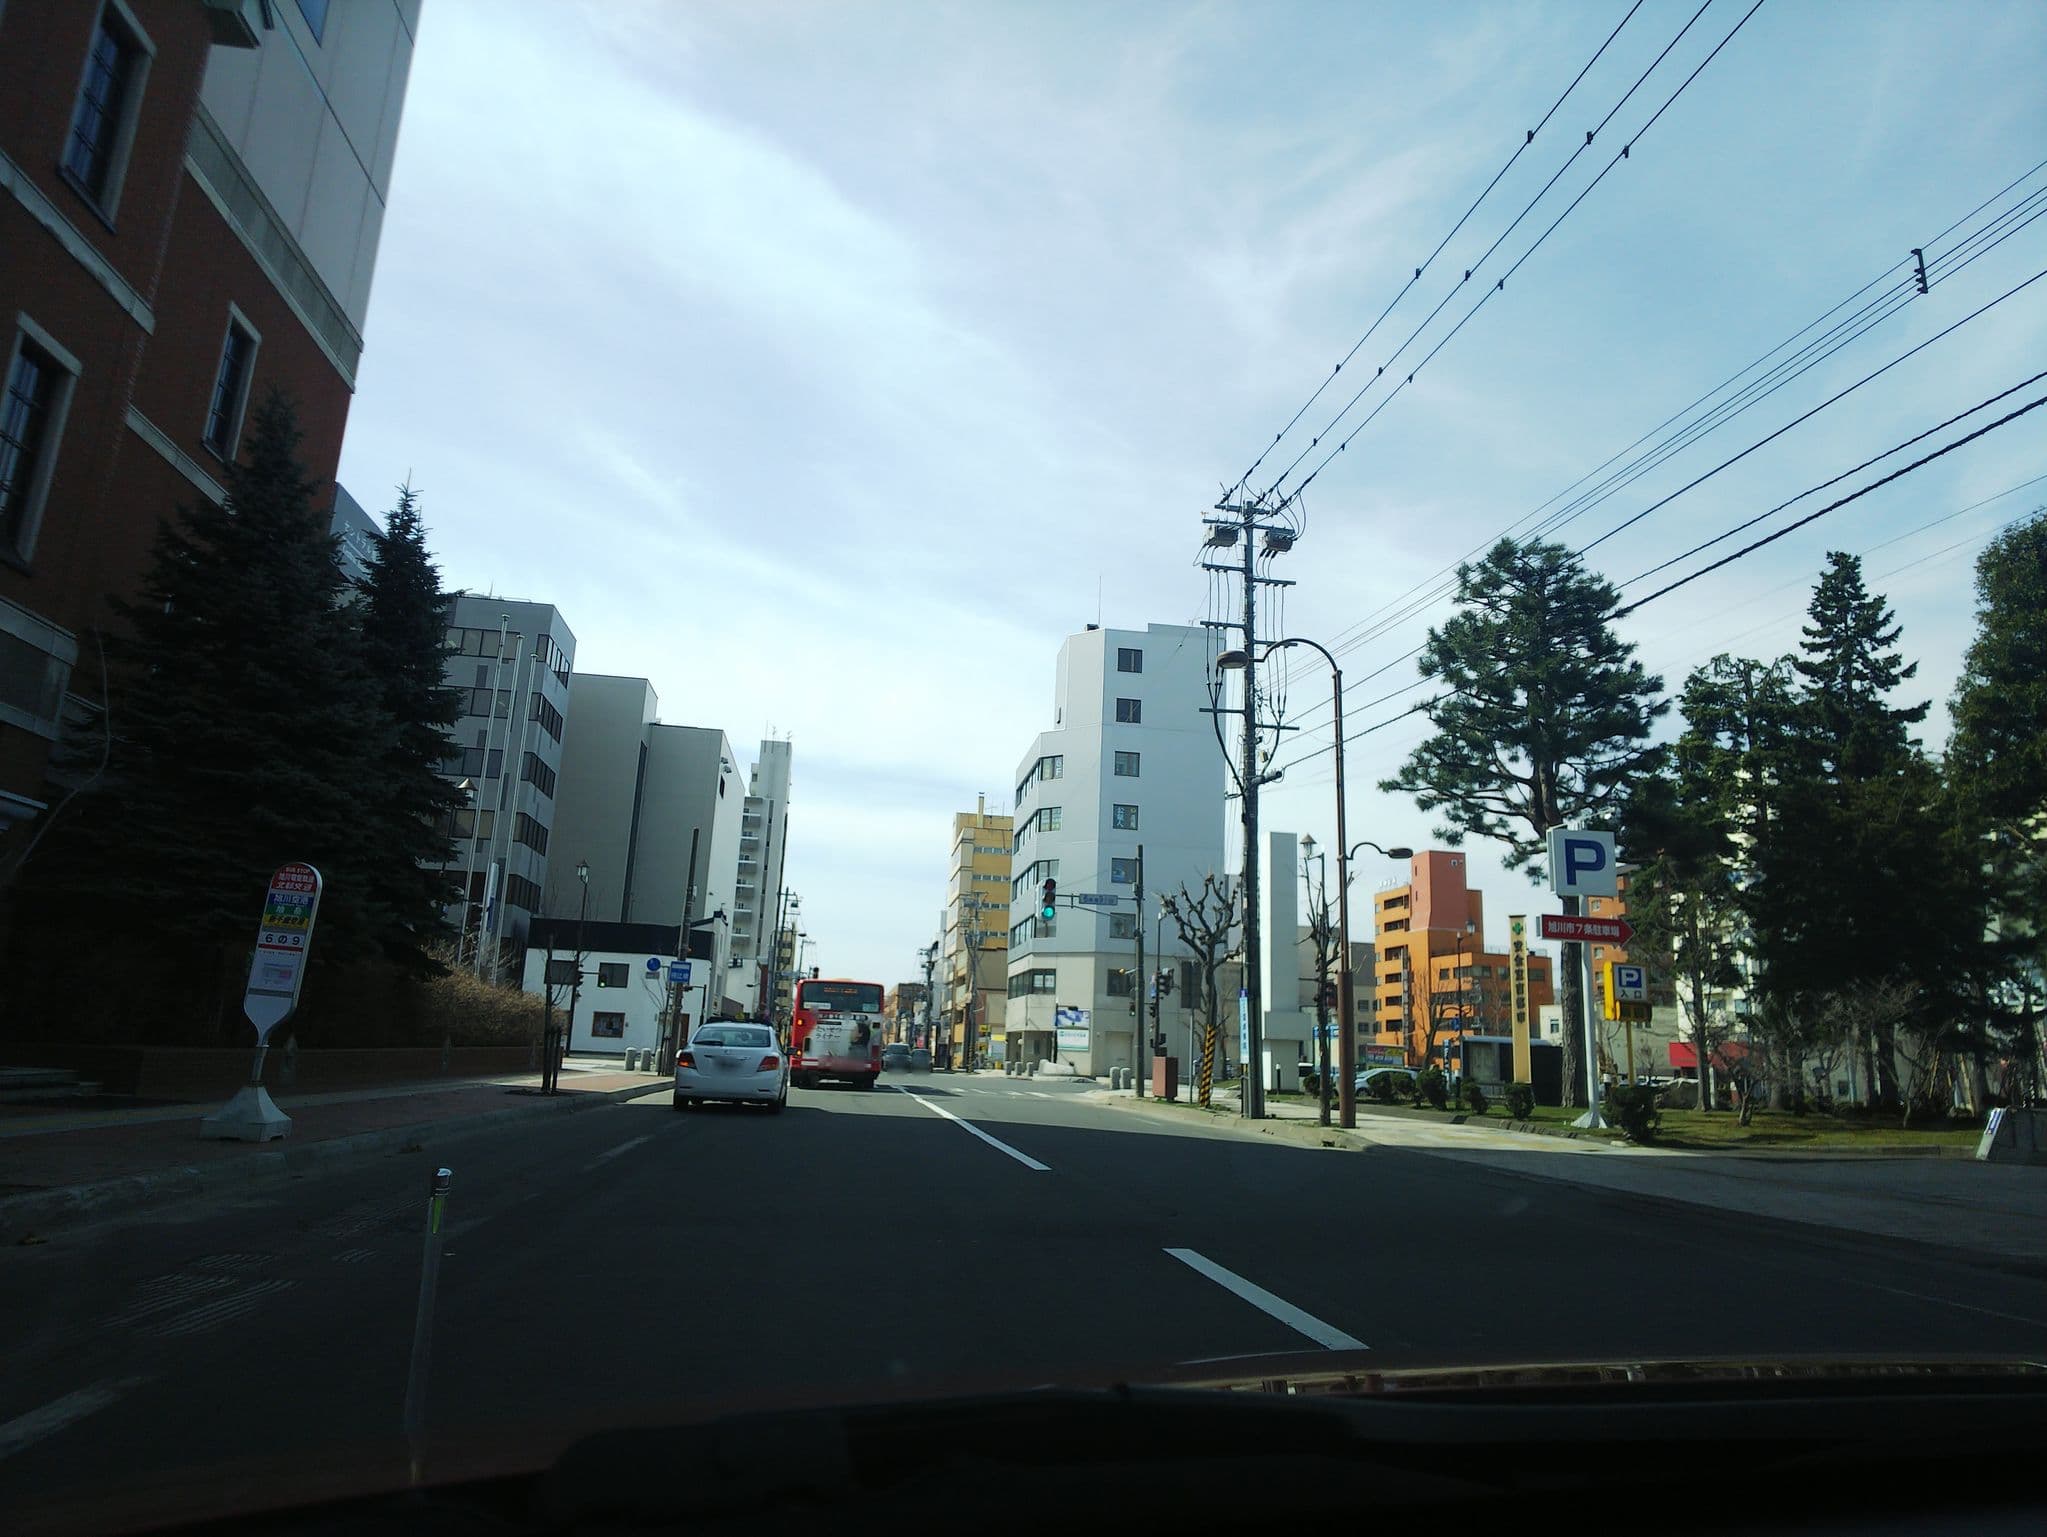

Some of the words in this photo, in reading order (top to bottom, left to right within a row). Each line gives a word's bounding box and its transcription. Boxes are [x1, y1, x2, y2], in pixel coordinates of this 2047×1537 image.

[1564, 838, 1606, 886] P
[265, 933, 300, 945] 6の9
[1621, 968, 1640, 987] P
[1620, 988, 1642, 999] 入口
